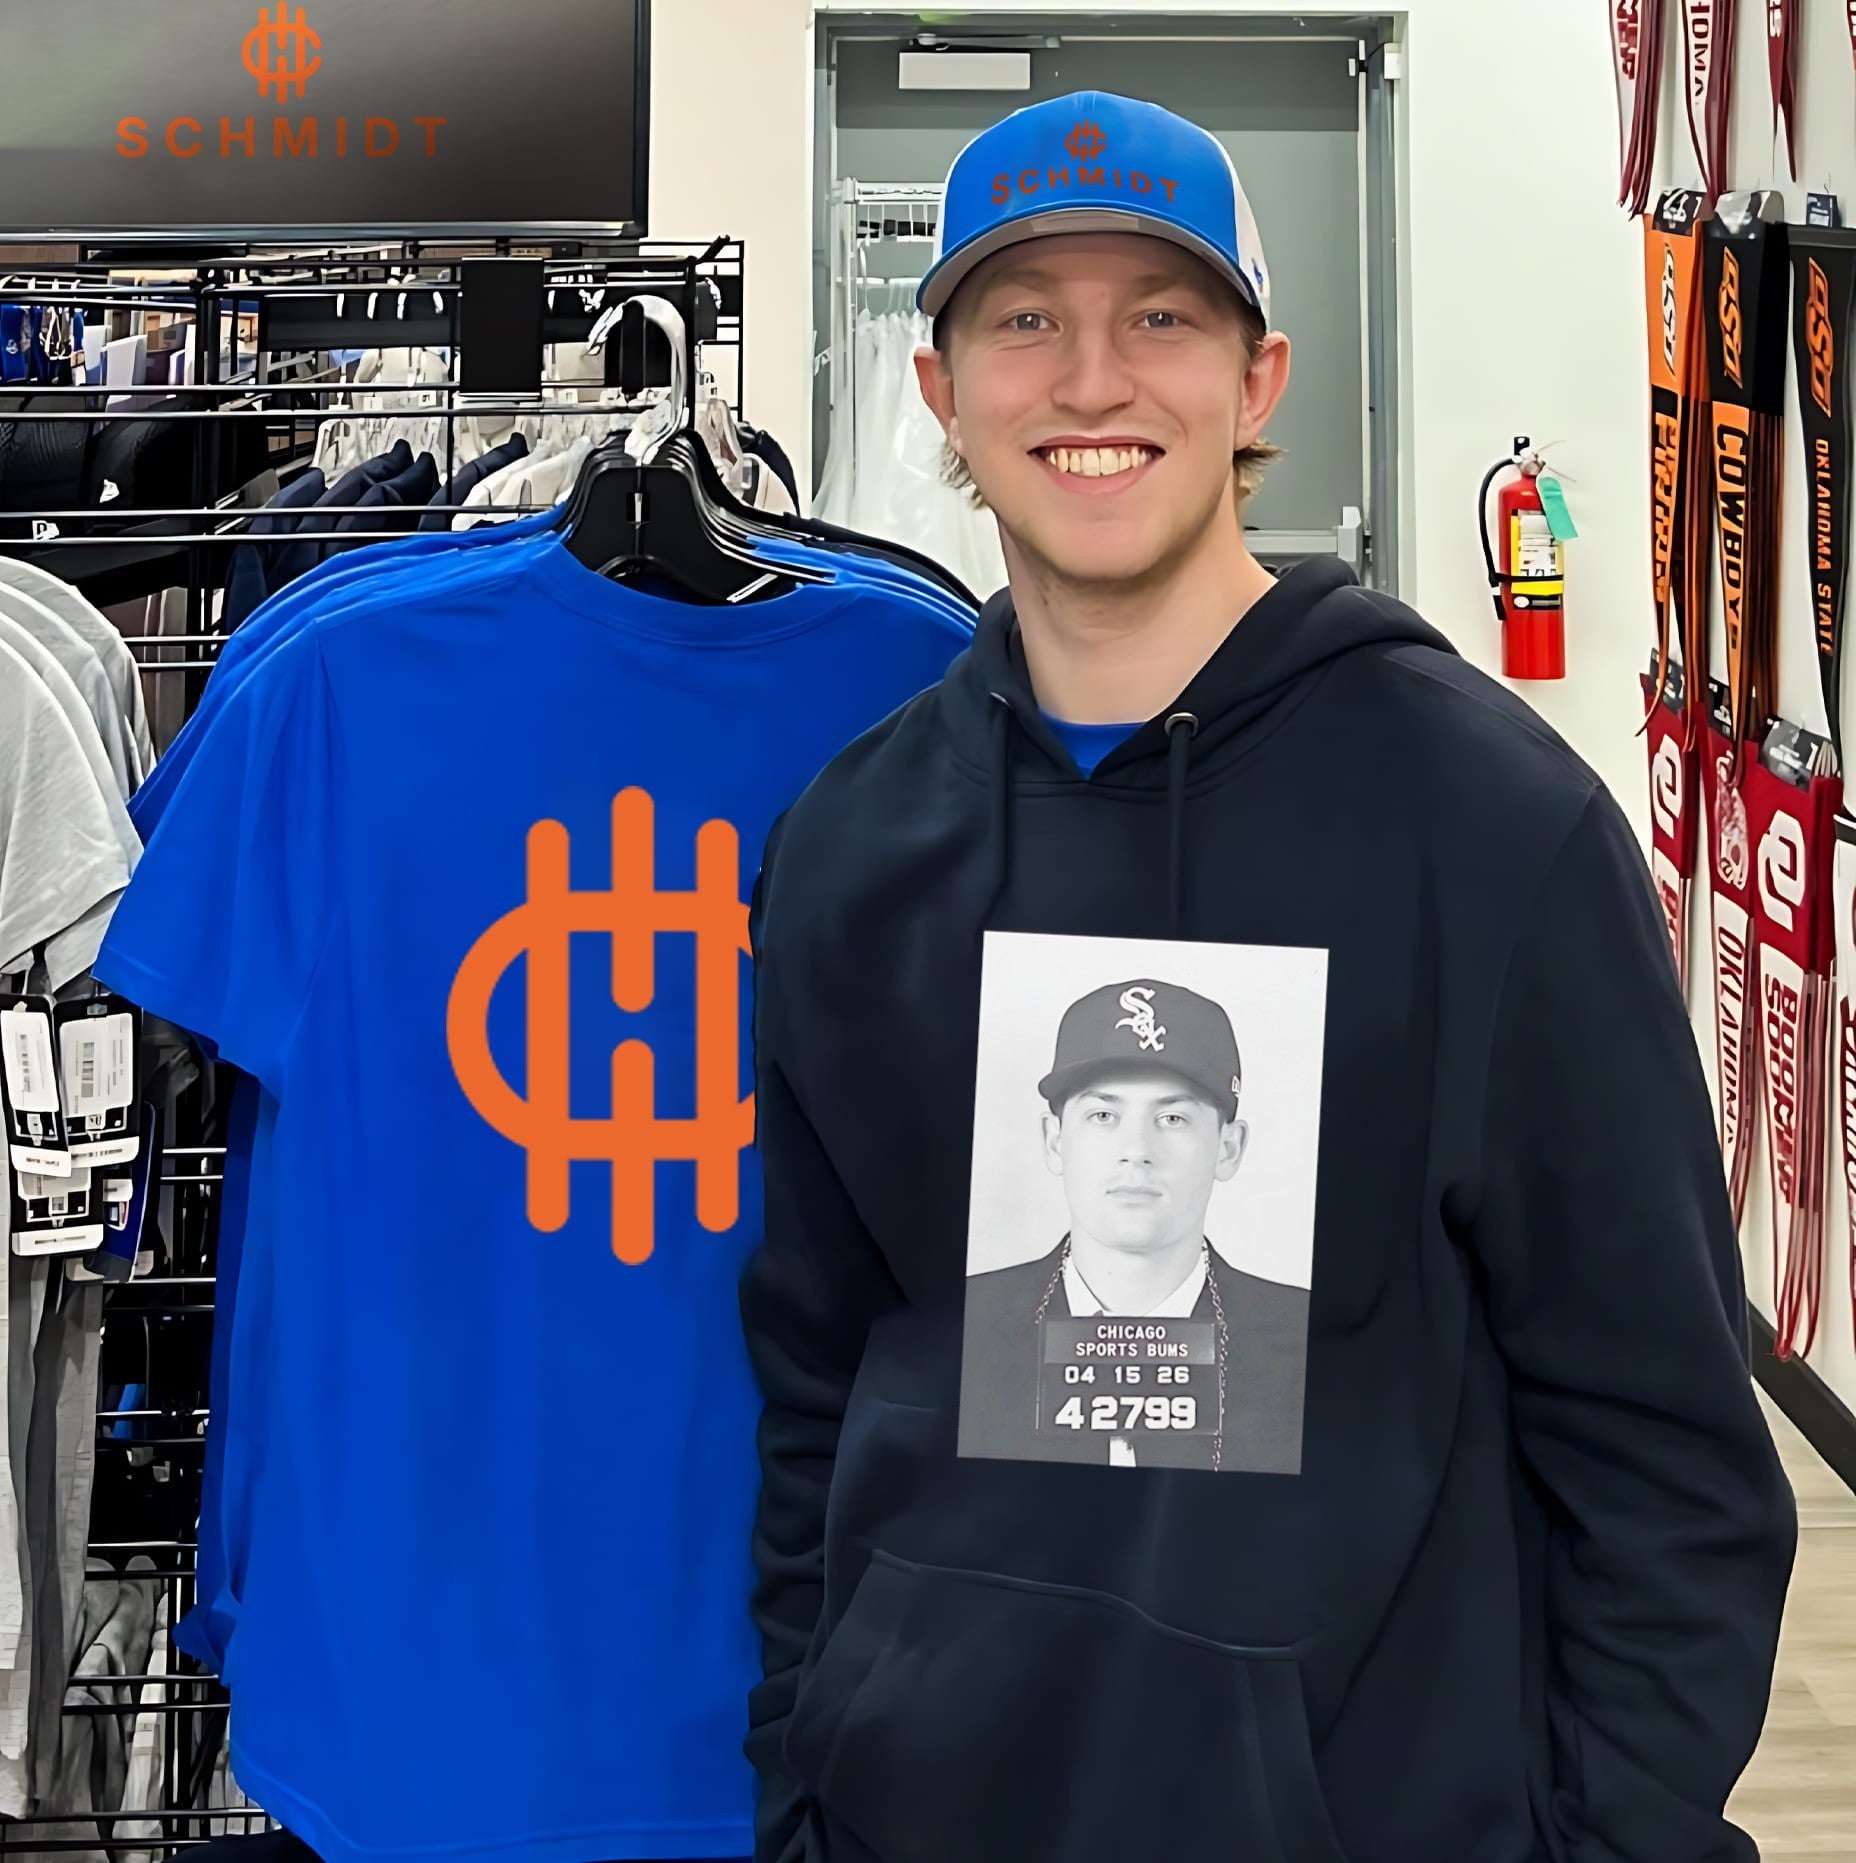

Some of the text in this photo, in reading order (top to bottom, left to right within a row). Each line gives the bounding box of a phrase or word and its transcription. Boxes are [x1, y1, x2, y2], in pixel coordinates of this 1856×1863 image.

[116, 117, 447, 158] SCHMIDT
[991, 166, 1180, 205] SCHMIDT
[1816, 438, 1832, 570] OKLAHOMA
[1076, 1343, 1188, 1357] SPORTS BUMS
[1097, 1325, 1166, 1340] CHICAGO
[1064, 1365, 1190, 1384] 04 15 26
[1055, 1395, 1197, 1430] 42799
